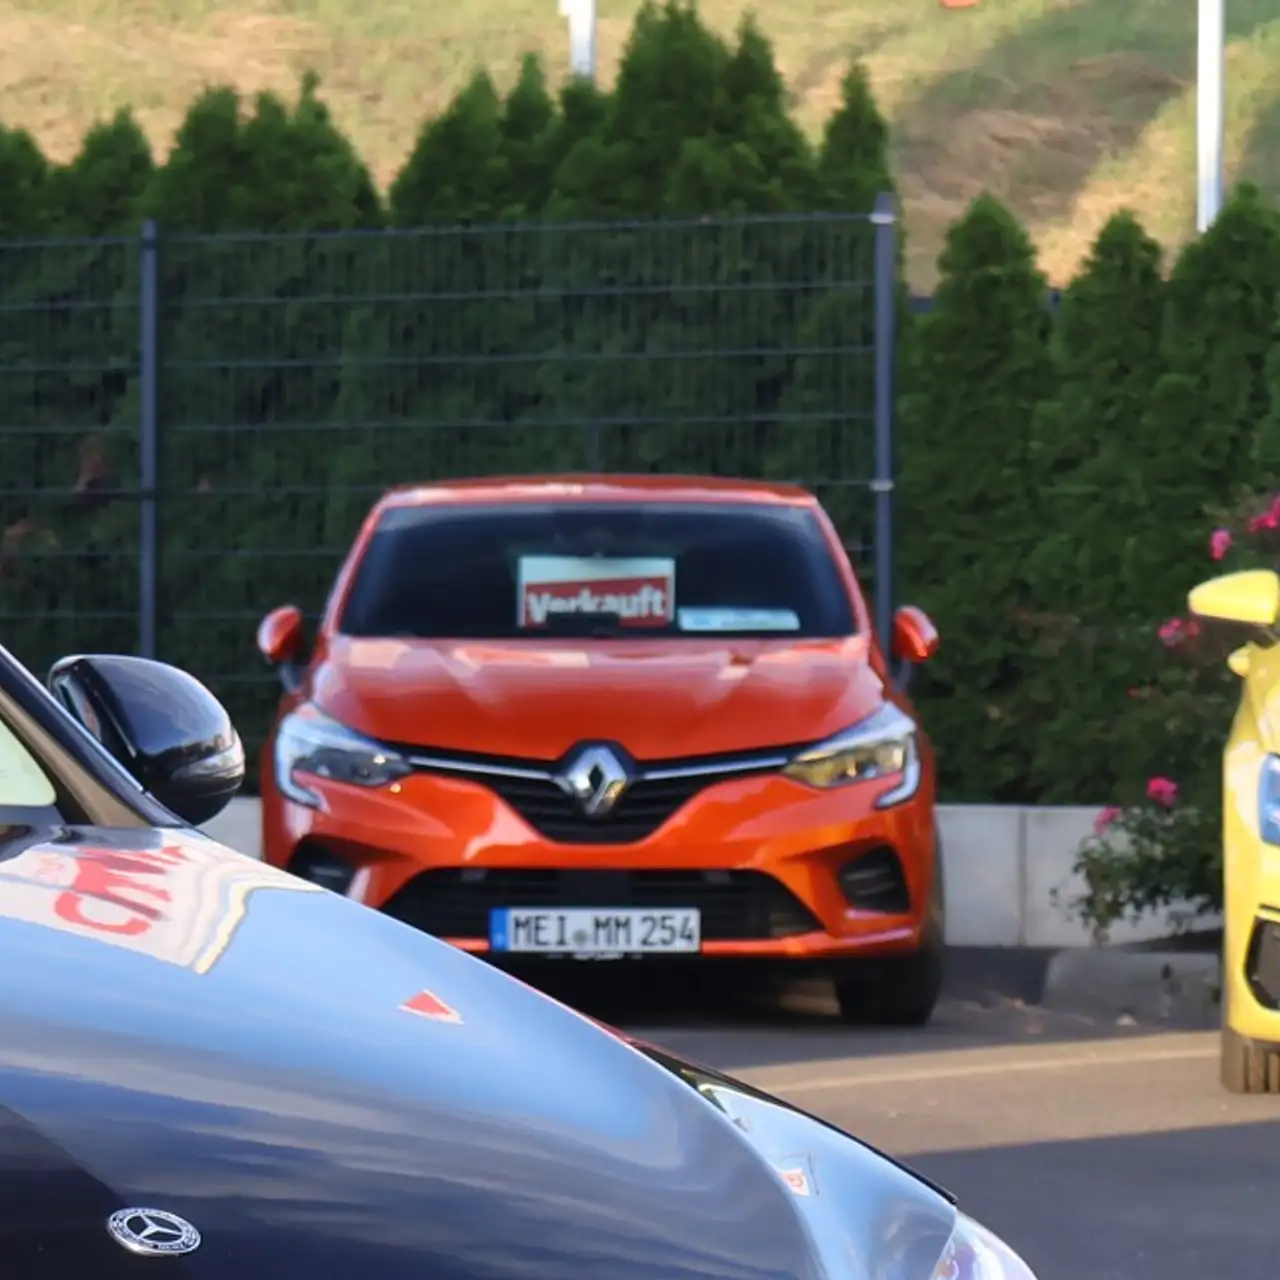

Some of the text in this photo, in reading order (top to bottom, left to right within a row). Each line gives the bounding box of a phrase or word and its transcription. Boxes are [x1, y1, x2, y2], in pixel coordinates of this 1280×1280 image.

[528, 585, 665, 623] Verkauft
[513, 915, 694, 946] MEI MM 254
